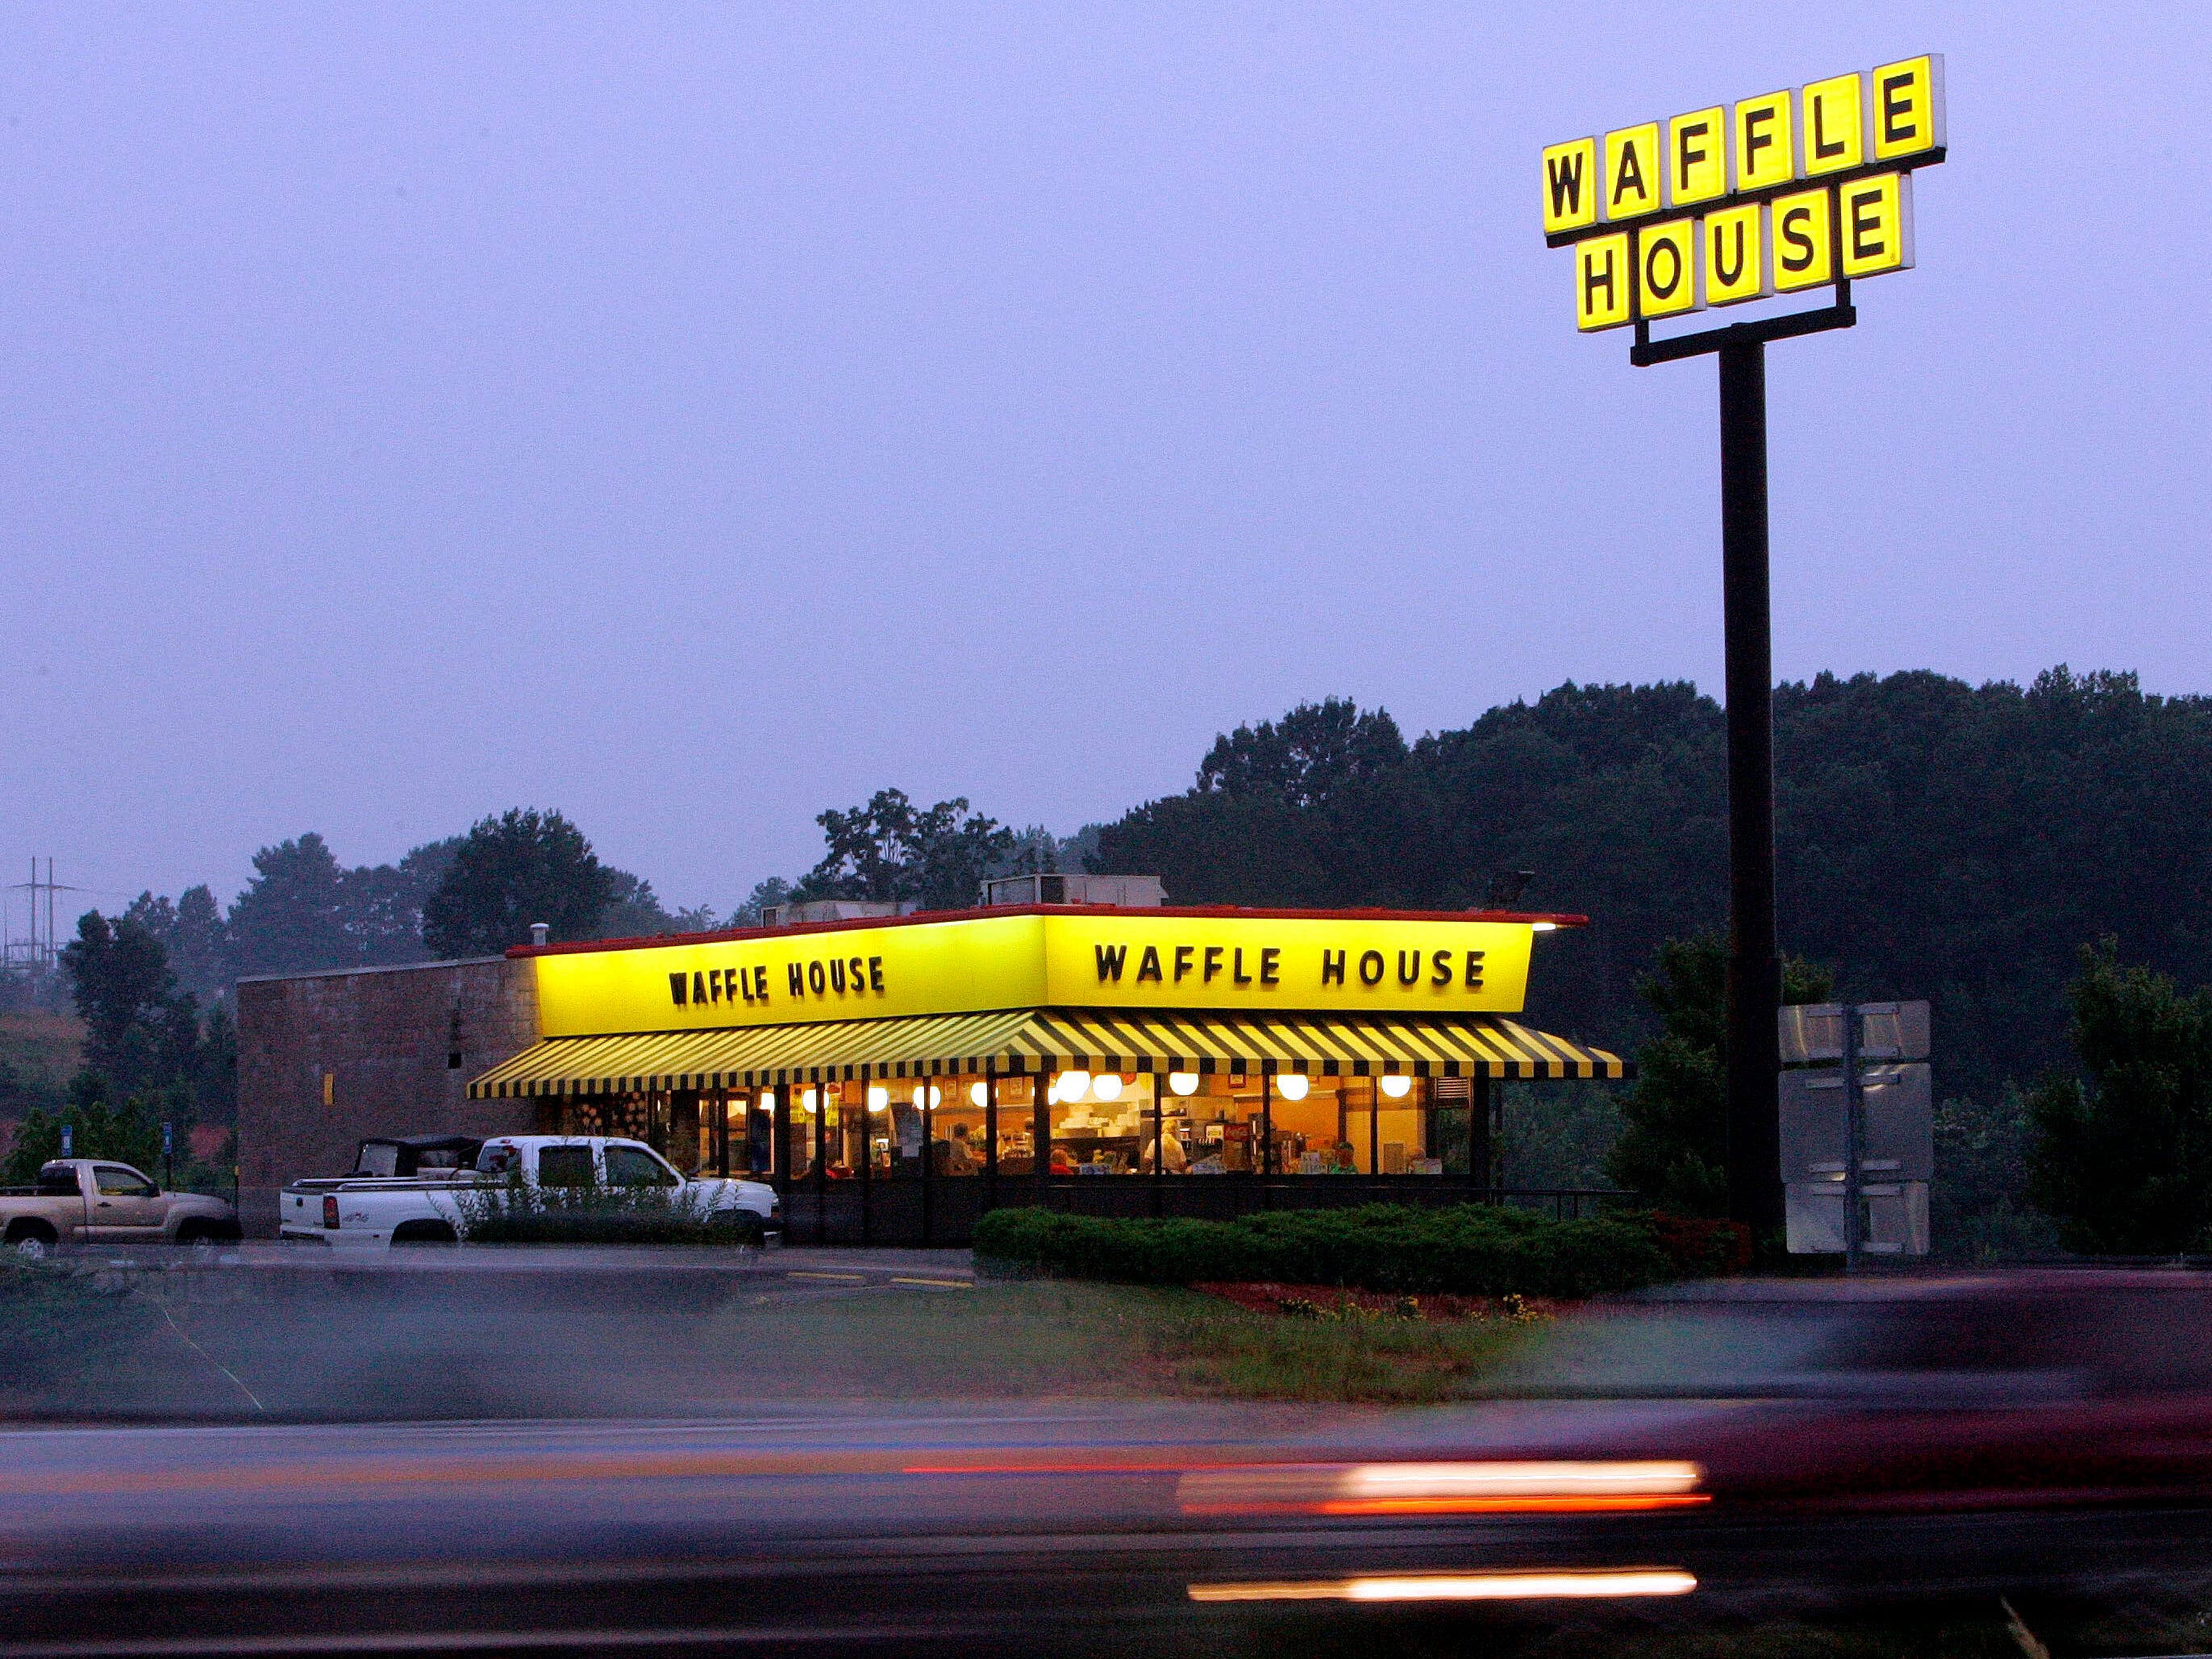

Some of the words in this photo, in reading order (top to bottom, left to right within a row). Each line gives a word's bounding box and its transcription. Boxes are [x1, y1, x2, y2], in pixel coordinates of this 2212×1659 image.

[1548, 72, 1916, 218] WAFFLE
[1584, 190, 1884, 315] HOUSE
[669, 966, 769, 1004] WAFFLE
[788, 956, 885, 997] HOUSE
[1094, 944, 1280, 984] WAFFLE
[1322, 949, 1485, 987] HOUSE
